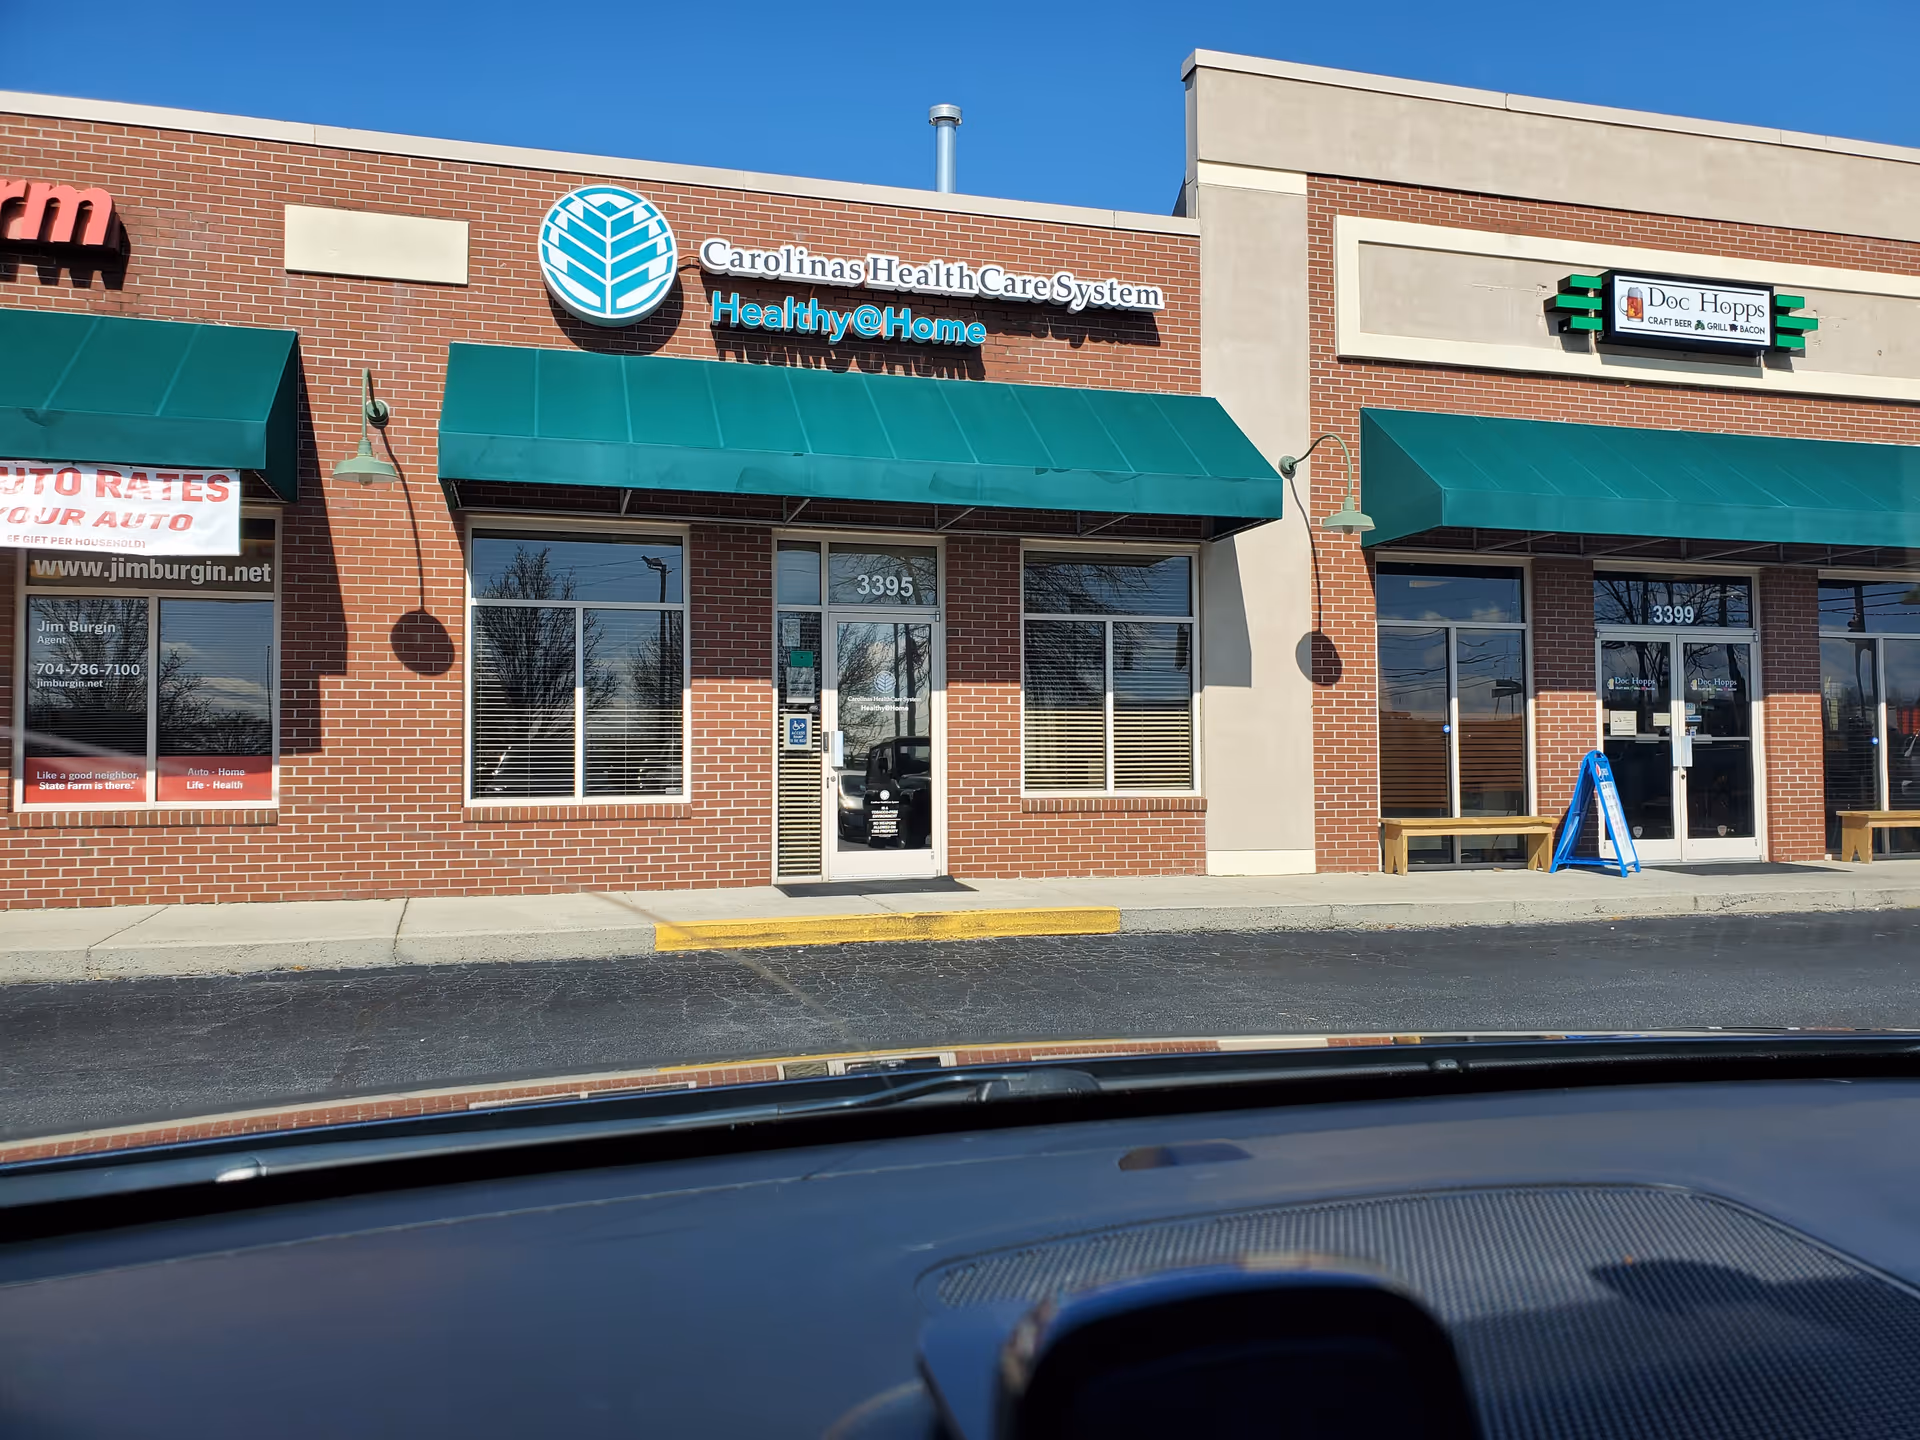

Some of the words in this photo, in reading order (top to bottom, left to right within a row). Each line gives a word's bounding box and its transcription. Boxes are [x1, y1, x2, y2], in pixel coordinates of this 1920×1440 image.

[702, 240, 864, 284] Carolinas
[1055, 273, 1163, 311] System
[1647, 286, 1690, 311] Doc
[1699, 291, 1765, 323] Hopps
[711, 290, 987, 344] Healthy@Home
[1647, 316, 1673, 327] CRAFT
[1674, 318, 1692, 329] BEER
[1706, 322, 1728, 332] GRILL
[1739, 325, 1766, 335] BACON
[95, 467, 231, 503] RATES
[92, 510, 194, 532] AUTO
[22, 535, 48, 545] GIFT
[50, 536, 73, 546] PER
[33, 556, 272, 586] www.jimburgin.net
[856, 574, 914, 597] 3395
[1653, 605, 1695, 624] 3399
[36, 620, 64, 633] Jim
[69, 621, 116, 635] Burgin
[37, 635, 66, 645] Agent
[36, 663, 141, 676] 704-786-7100
[36, 678, 104, 689] jimburgin.net
[1614, 676, 1629, 685] Doc
[1631, 676, 1655, 686] Hopps
[1697, 677, 1711, 685] Doc
[1713, 677, 1737, 687] Hopps
[36, 771, 57, 780] Like
[59, 772, 66, 780] a
[68, 771, 93, 781] good
[95, 771, 139, 781] neighbor,
[187, 767, 209, 776] Auto
[218, 767, 245, 776] Home
[39, 781, 66, 790] State
[67, 781, 93, 790] Farm
[94, 781, 103, 790] is
[186, 780, 205, 790] Life
[212, 780, 244, 790] Health
